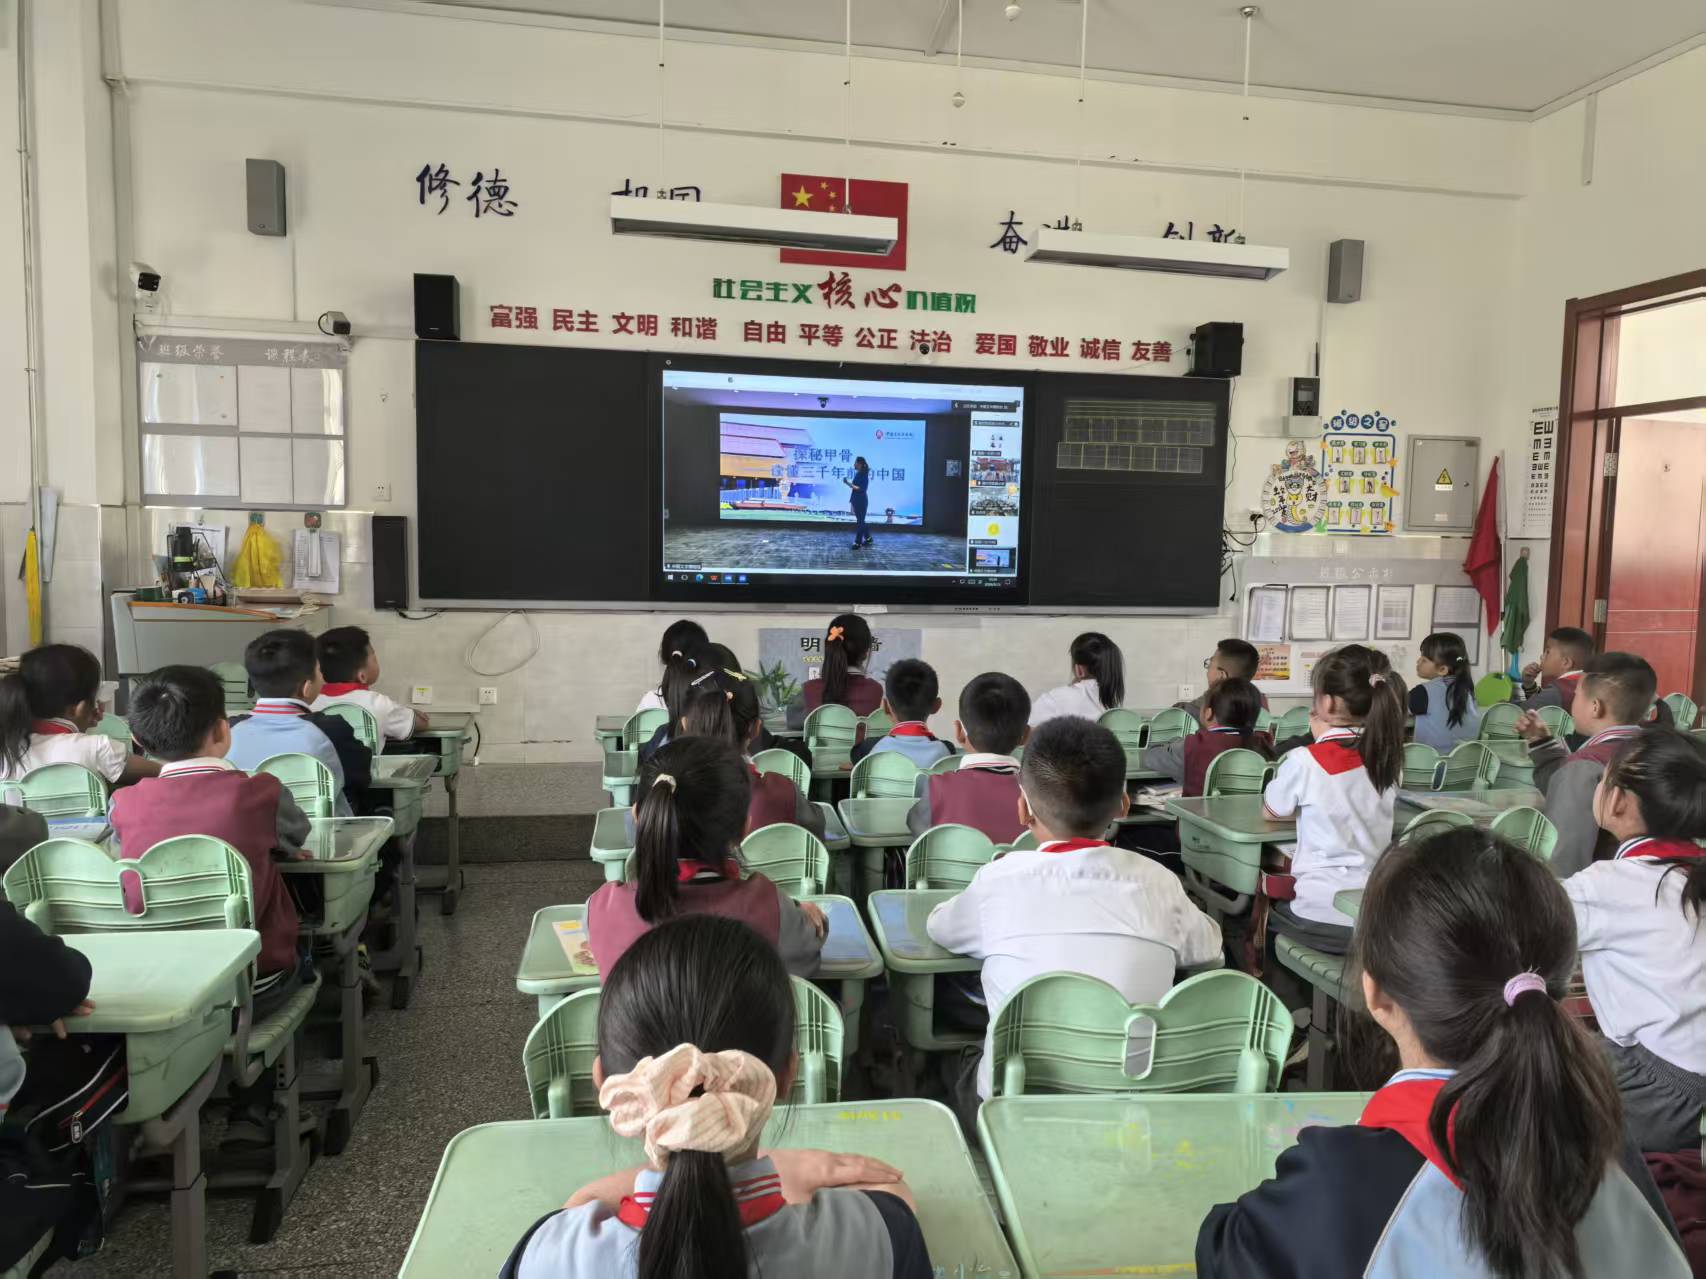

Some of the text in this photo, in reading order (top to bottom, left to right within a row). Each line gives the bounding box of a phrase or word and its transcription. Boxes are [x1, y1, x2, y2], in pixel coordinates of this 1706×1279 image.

[416, 163, 518, 218] 修德
[490, 304, 1172, 362] 富强 民主 文明 和谐 自由 平等 公正 法治 爱国 敬业 诚信 友善
